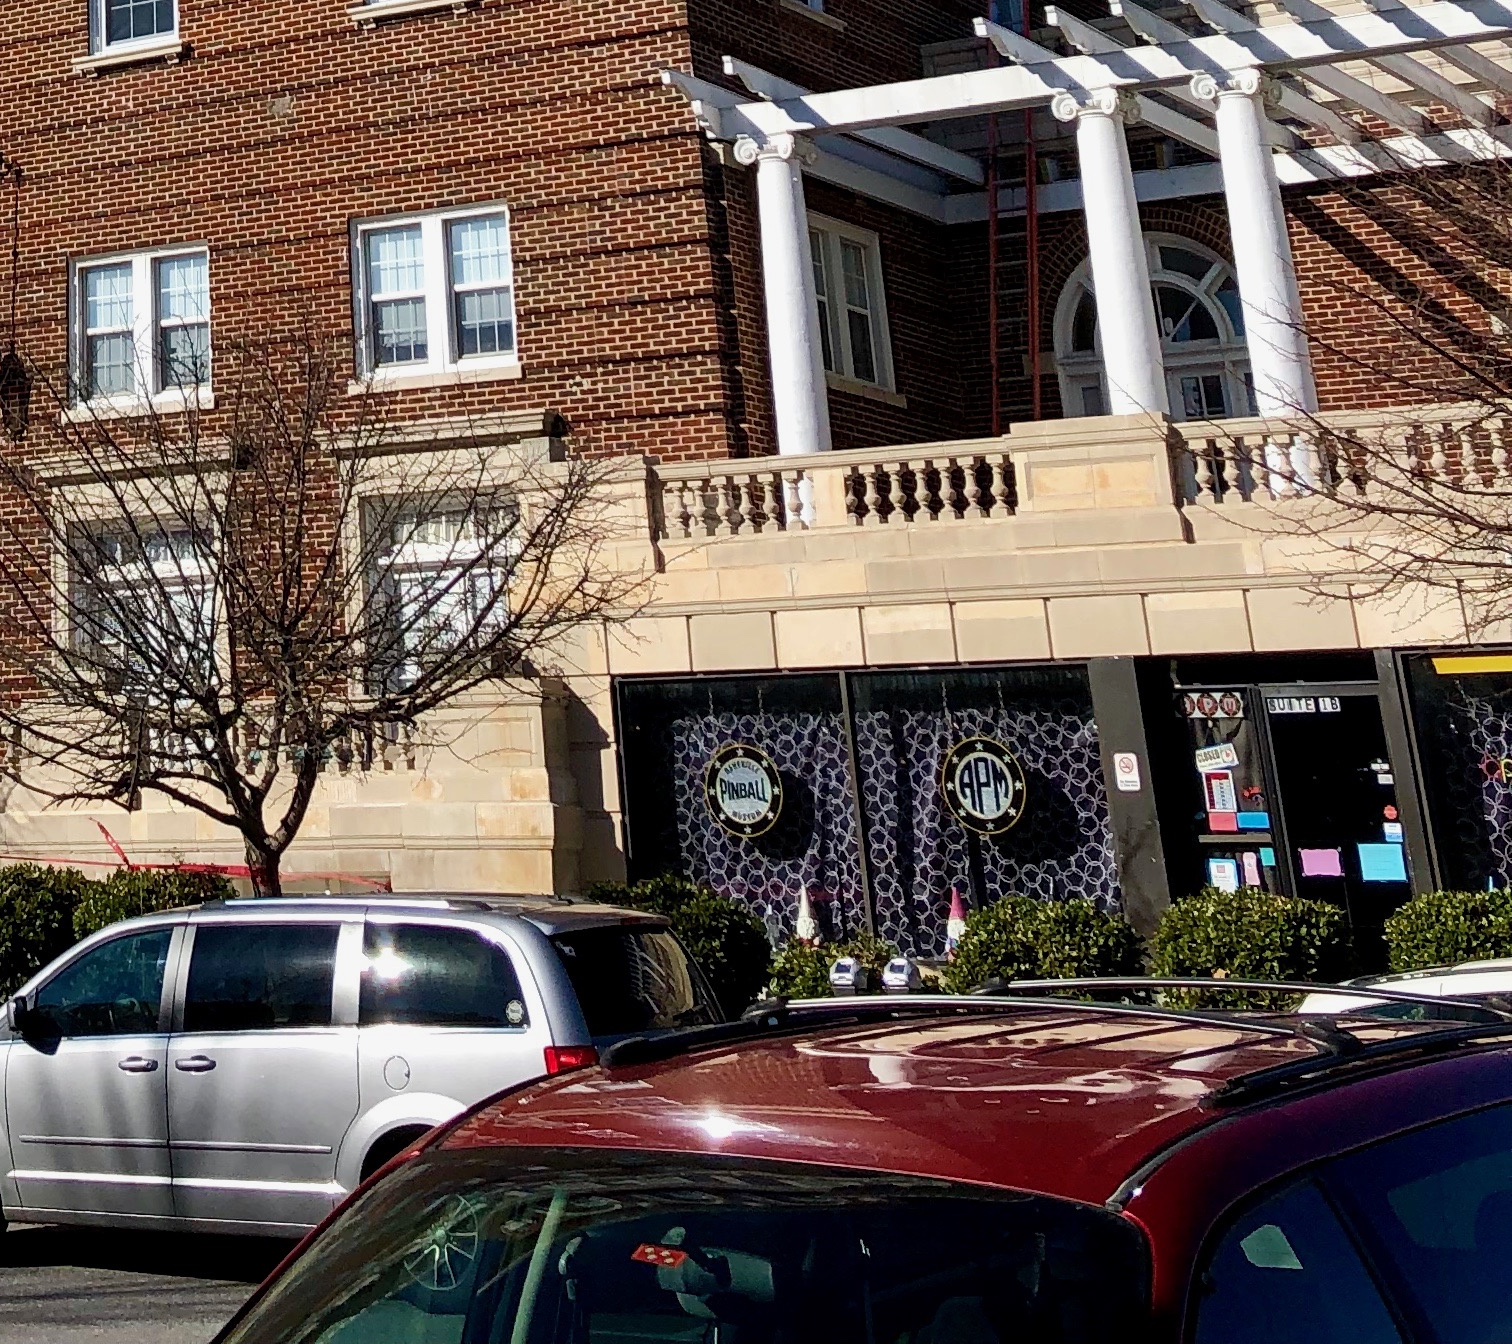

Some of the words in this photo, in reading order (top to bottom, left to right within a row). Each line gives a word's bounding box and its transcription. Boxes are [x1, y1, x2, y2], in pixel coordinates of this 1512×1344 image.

[1268, 698, 1314, 712] SUITE
[1197, 749, 1221, 764] CLOSED
[719, 777, 769, 804] PINBALL
[959, 757, 1009, 814] APM
